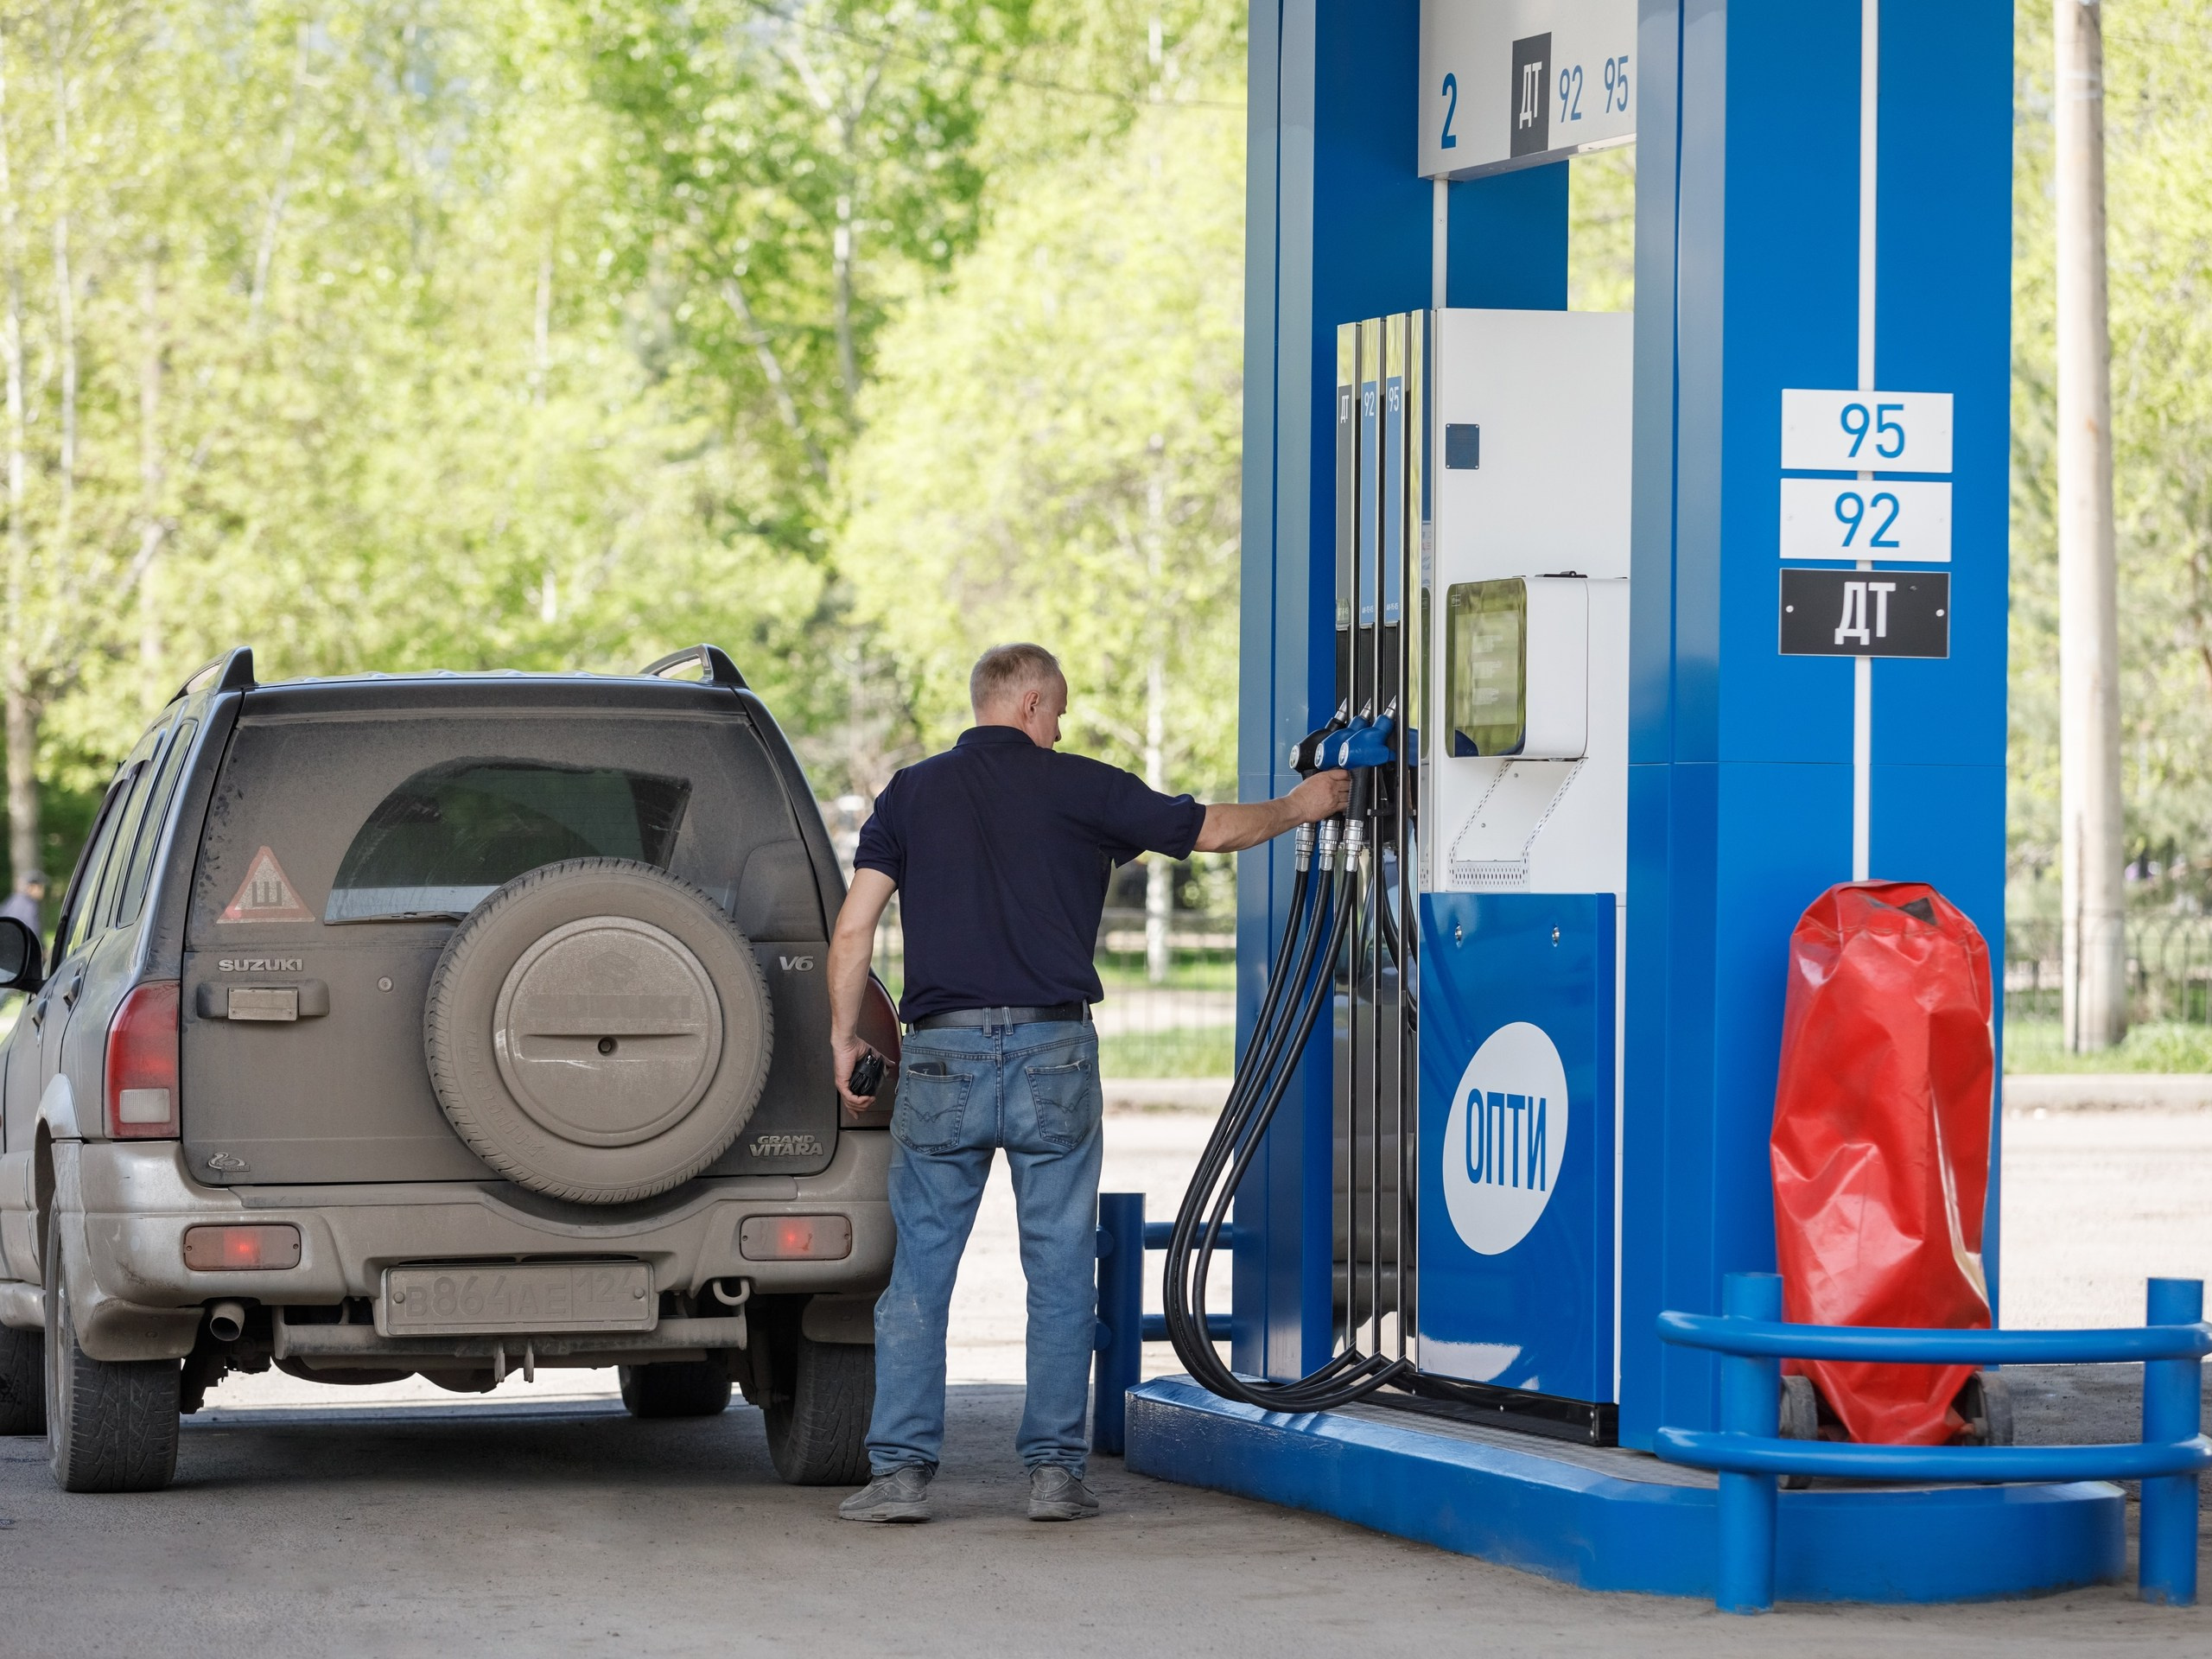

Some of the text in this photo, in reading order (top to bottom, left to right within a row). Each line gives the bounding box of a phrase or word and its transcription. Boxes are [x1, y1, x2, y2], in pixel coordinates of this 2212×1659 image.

[1519, 60, 1542, 130] ДТ
[1559, 54, 1629, 123] 92 95
[1441, 73, 1458, 149] 2
[1364, 391, 1375, 416] 92
[1389, 386, 1399, 412] 95
[1840, 403, 1905, 459] 95
[1834, 492, 1900, 548] 92
[1834, 581, 1897, 645] ДТ
[251, 881, 283, 906] Ш
[218, 958, 303, 972] SUZUKI
[779, 956, 814, 971] V6
[749, 1142, 824, 1158] VITARA
[757, 1135, 816, 1144] GRAND
[1465, 1088, 1547, 1192] ОПТИ
